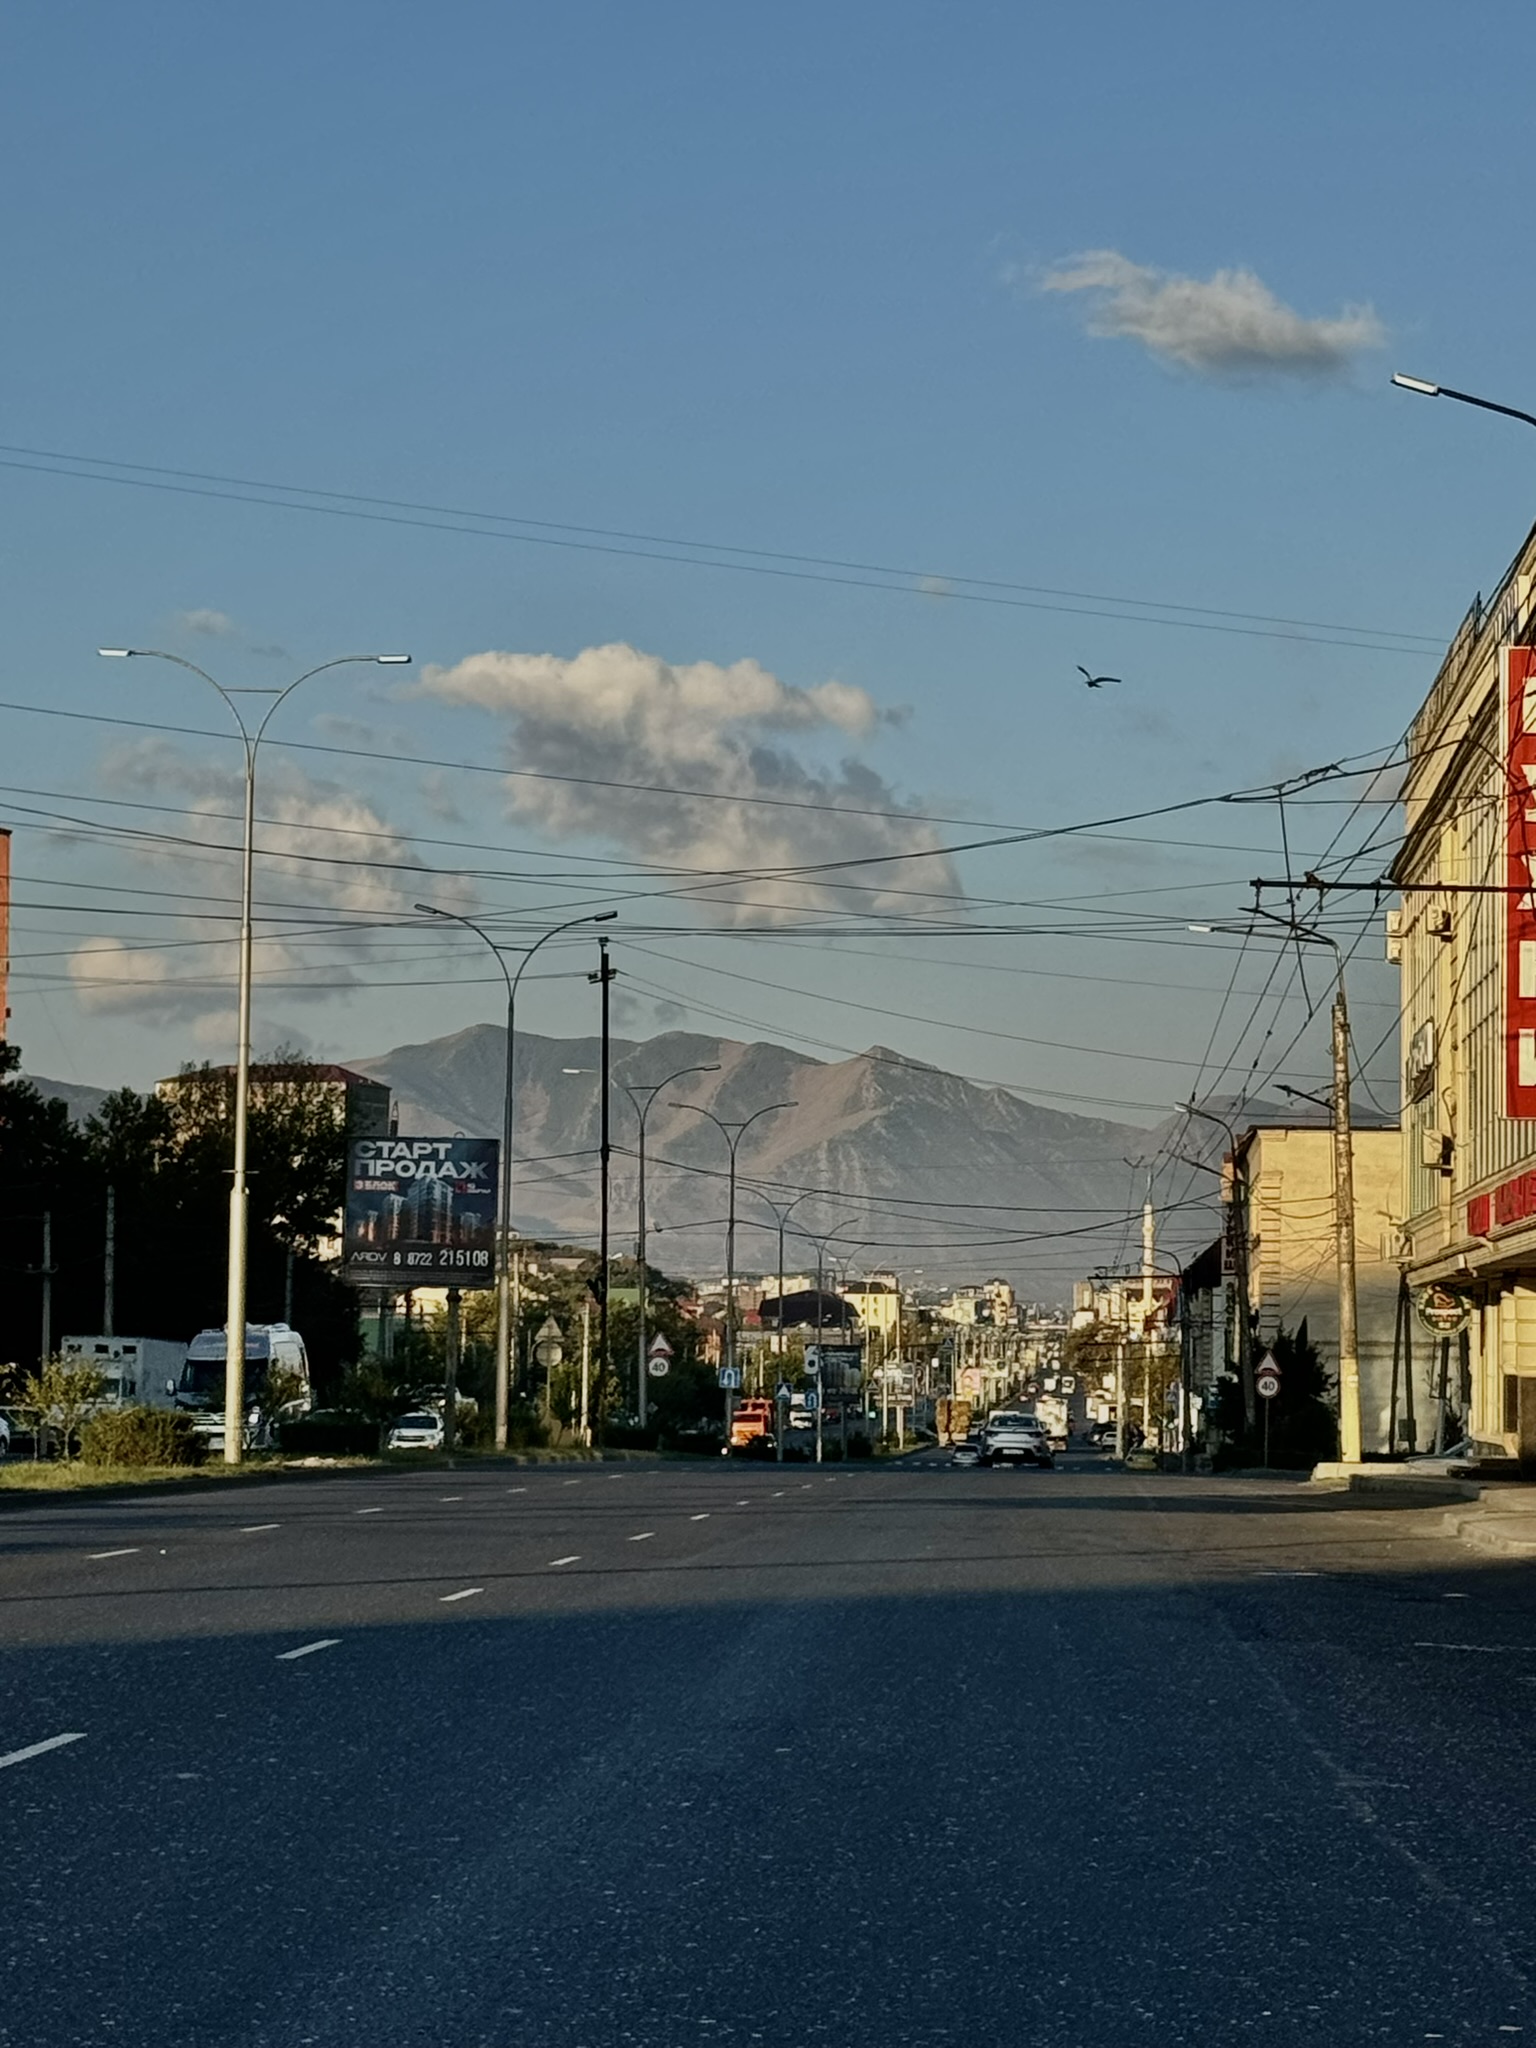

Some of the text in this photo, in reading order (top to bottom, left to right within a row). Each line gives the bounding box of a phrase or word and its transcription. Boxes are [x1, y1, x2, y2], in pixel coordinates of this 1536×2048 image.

[355, 1140, 452, 1160] СТАРТ
[354, 1159, 489, 1179] ПРОДАЖ
[393, 1249, 489, 1267] 8 8722 215108
[651, 1361, 666, 1372] 40
[1261, 1380, 1276, 1391] 40
